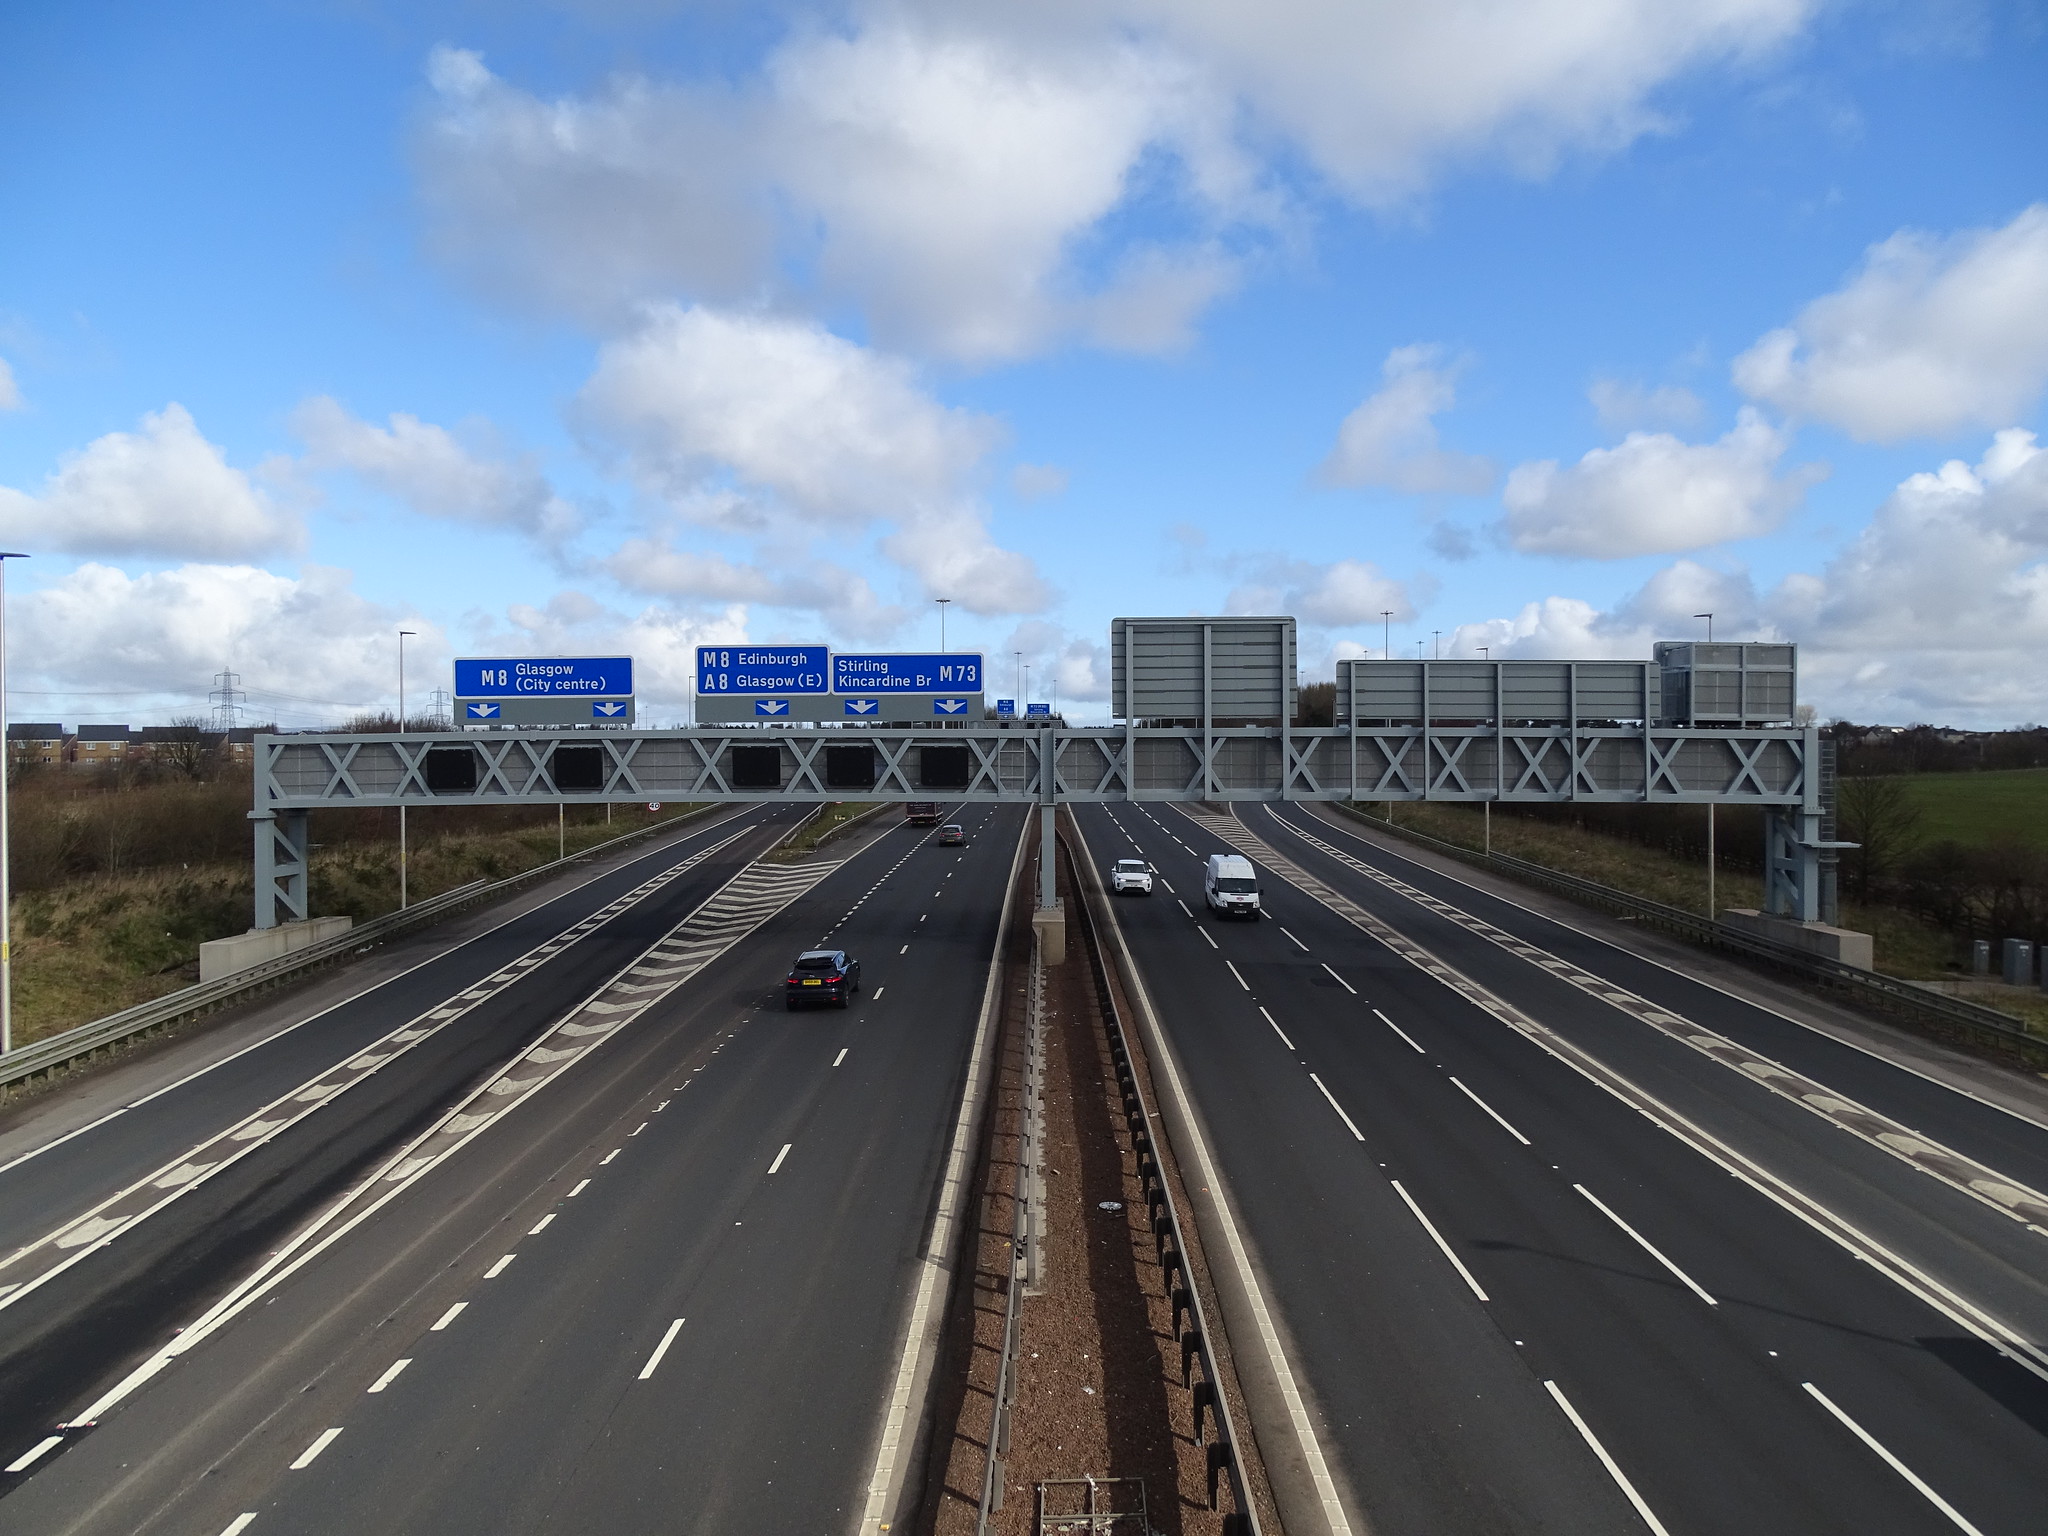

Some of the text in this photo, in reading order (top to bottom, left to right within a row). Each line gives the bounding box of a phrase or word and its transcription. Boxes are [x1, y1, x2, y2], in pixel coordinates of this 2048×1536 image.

[738, 652, 807, 667] Edinburgh
[838, 659, 888, 674] Stirling
[515, 663, 574, 677] Glasgow
[515, 676, 606, 693] (City centre)
[736, 674, 795, 689] Glasgow
[838, 674, 932, 687] Kincardine Br
